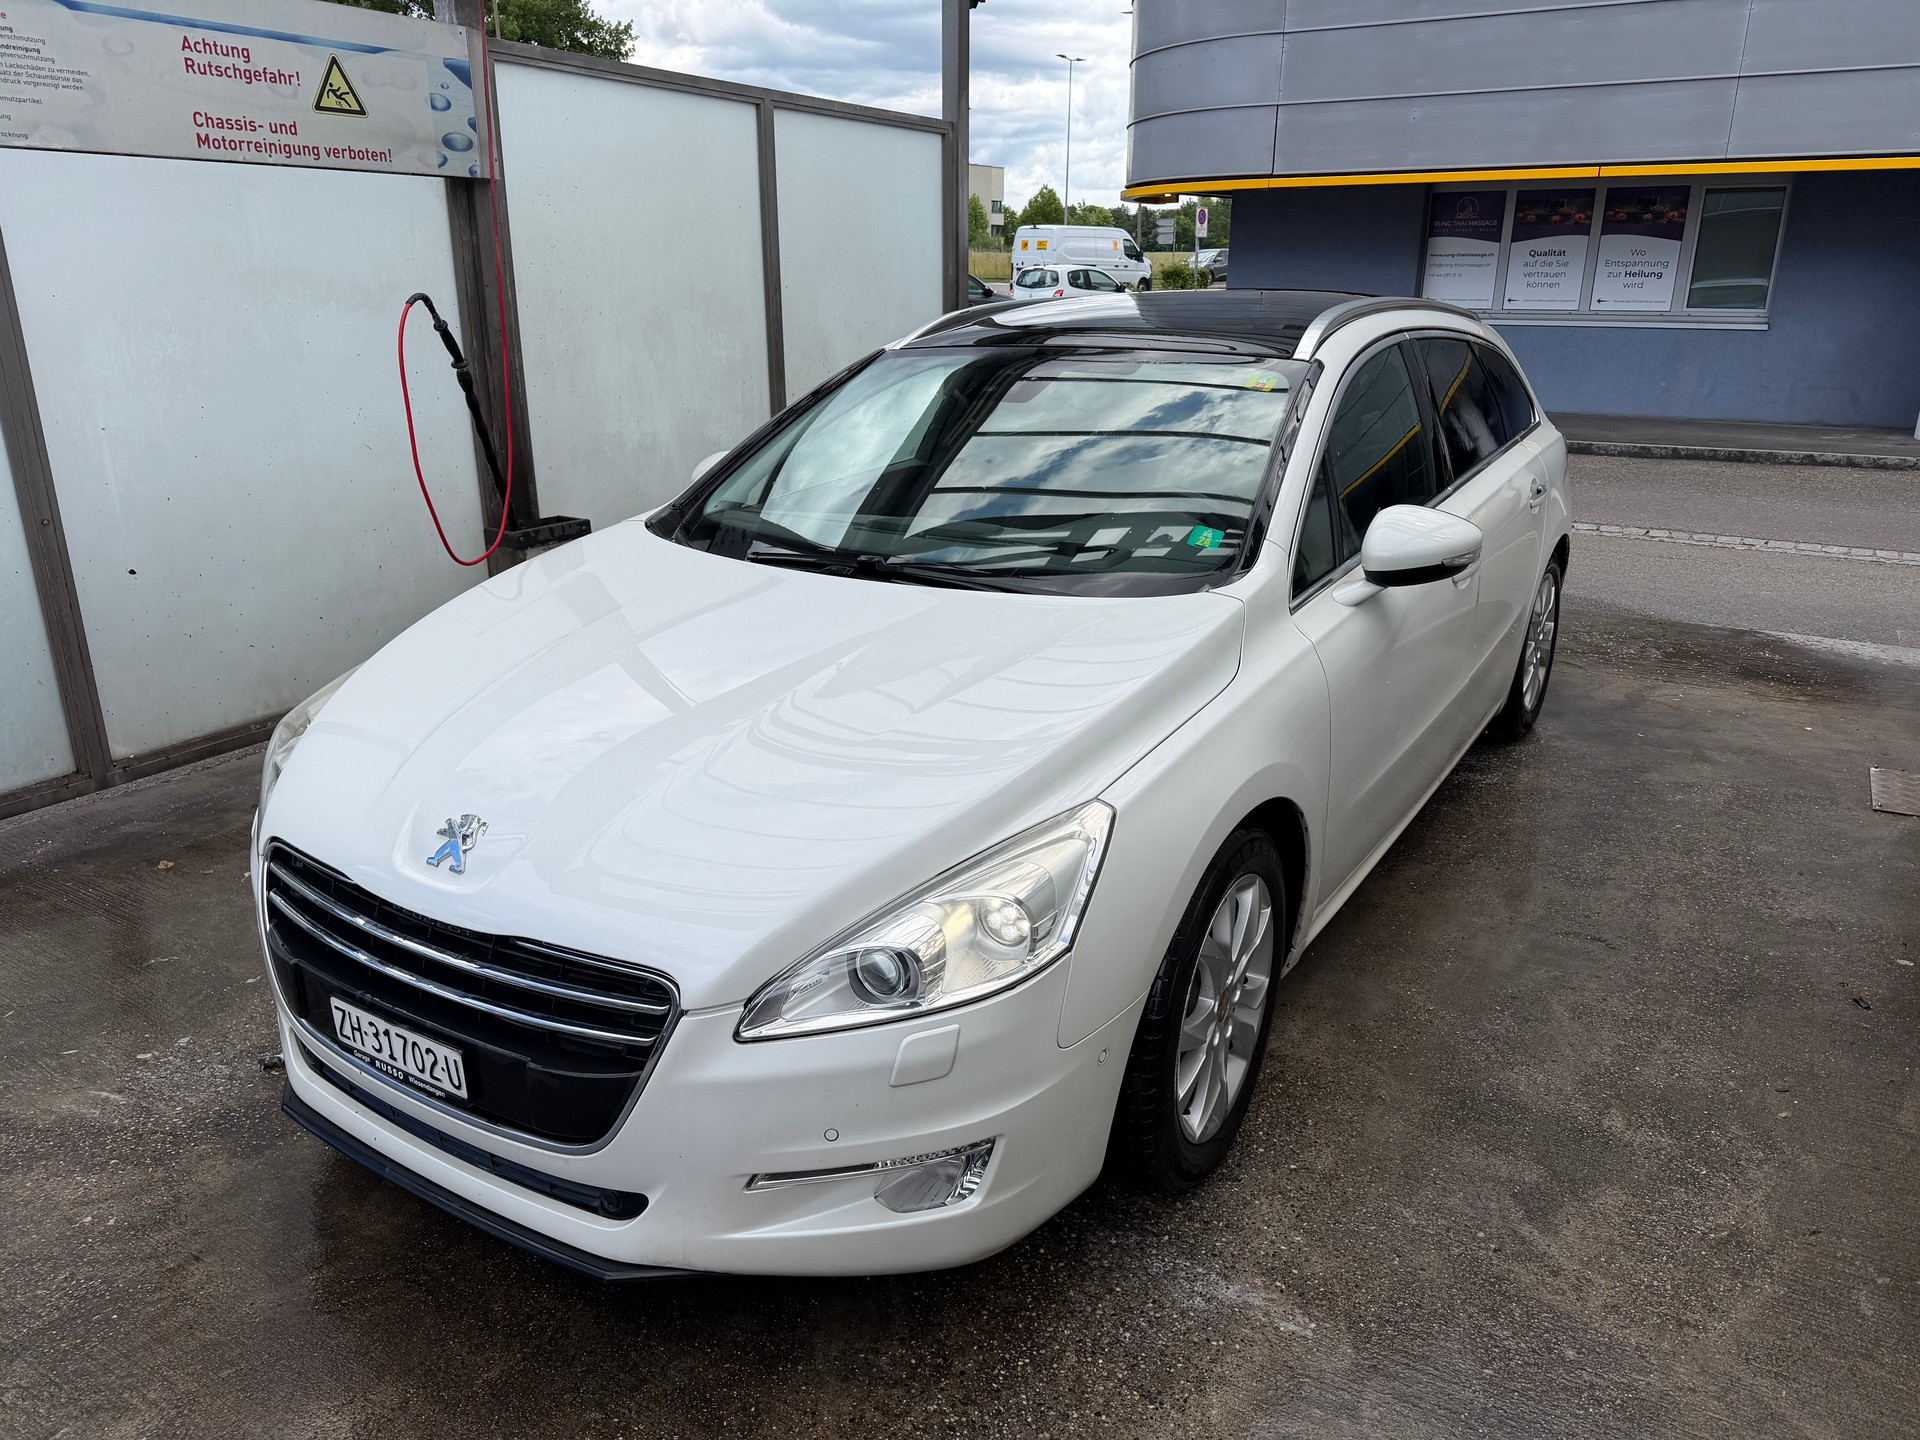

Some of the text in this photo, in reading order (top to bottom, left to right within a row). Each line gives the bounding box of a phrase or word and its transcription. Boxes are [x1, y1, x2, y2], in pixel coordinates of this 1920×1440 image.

[0, 25, 13, 33] ung
[181, 35, 250, 63] Achtung
[5, 62, 46, 72] Lackschäden
[56, 68, 90, 77] vermeiden,
[183, 57, 301, 87] Rutschgefahr!
[25, 71, 71, 83] Schaumbürste
[23, 80, 60, 89] vorgereinigt
[61, 83, 84, 91] werden
[193, 111, 298, 136] Chassis- und
[196, 132, 392, 162] Motorreinigung verboten!
[1528, 249, 1567, 259] Qualität
[1630, 249, 1646, 257] Wo
[1523, 260, 1539, 268] auf
[1555, 260, 1569, 268] Sie
[1605, 259, 1669, 269] Entspannung
[1624, 270, 1663, 279] Heilung
[1526, 280, 1560, 288] können
[1623, 281, 1644, 289] wird
[1195, 535, 1211, 548] 24
[375, 1060, 404, 1080] RUSSO
[408, 1075, 446, 1098] Wiesendangen
